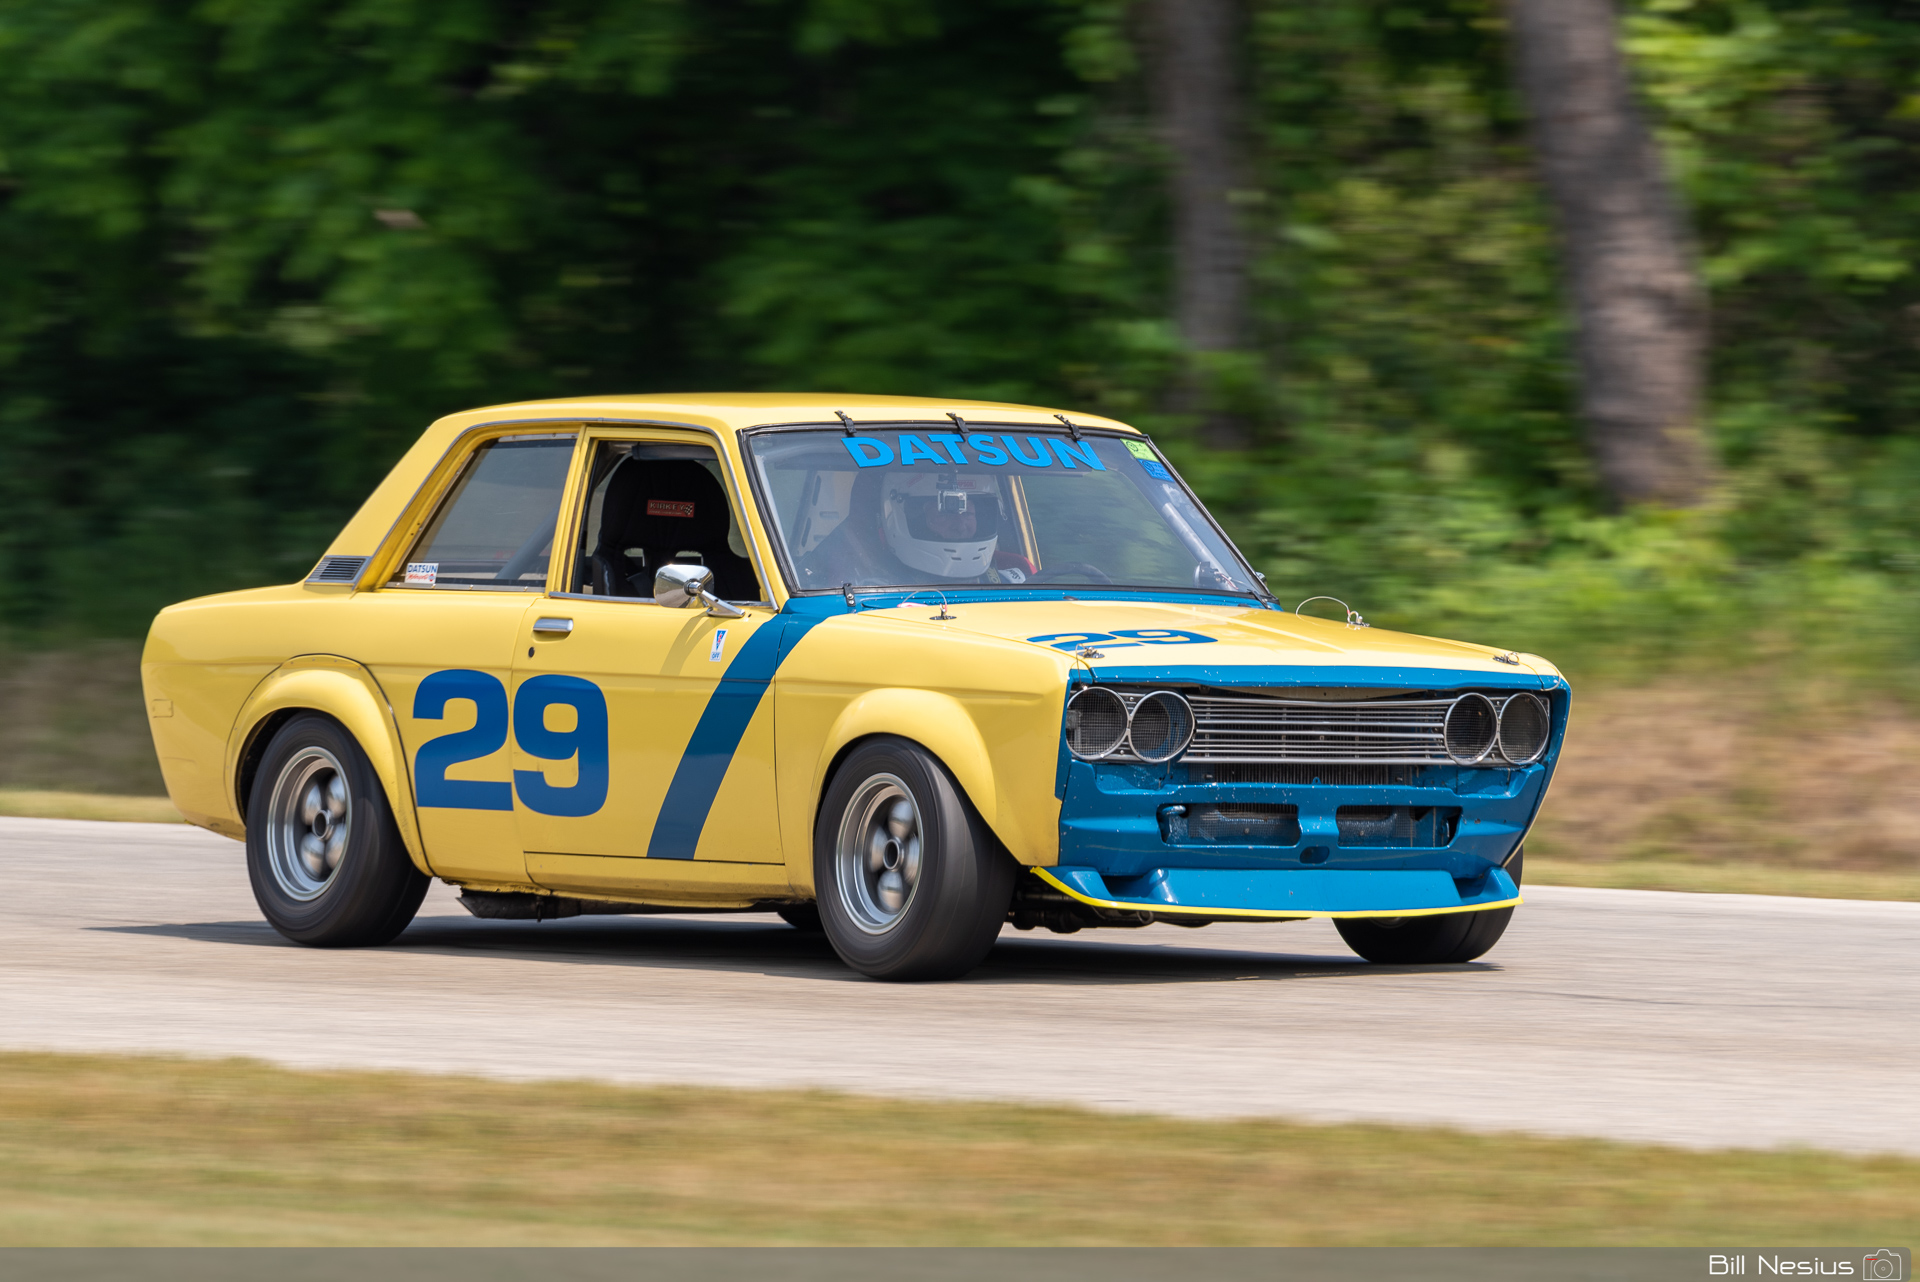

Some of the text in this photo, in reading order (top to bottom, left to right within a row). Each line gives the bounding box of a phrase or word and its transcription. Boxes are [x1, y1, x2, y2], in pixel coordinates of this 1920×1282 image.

[841, 433, 1107, 471] DATSUN
[650, 502, 685, 510] KIRKEY
[407, 564, 438, 573] DATSUN
[1026, 628, 1219, 652] 29
[412, 669, 609, 818] 29
